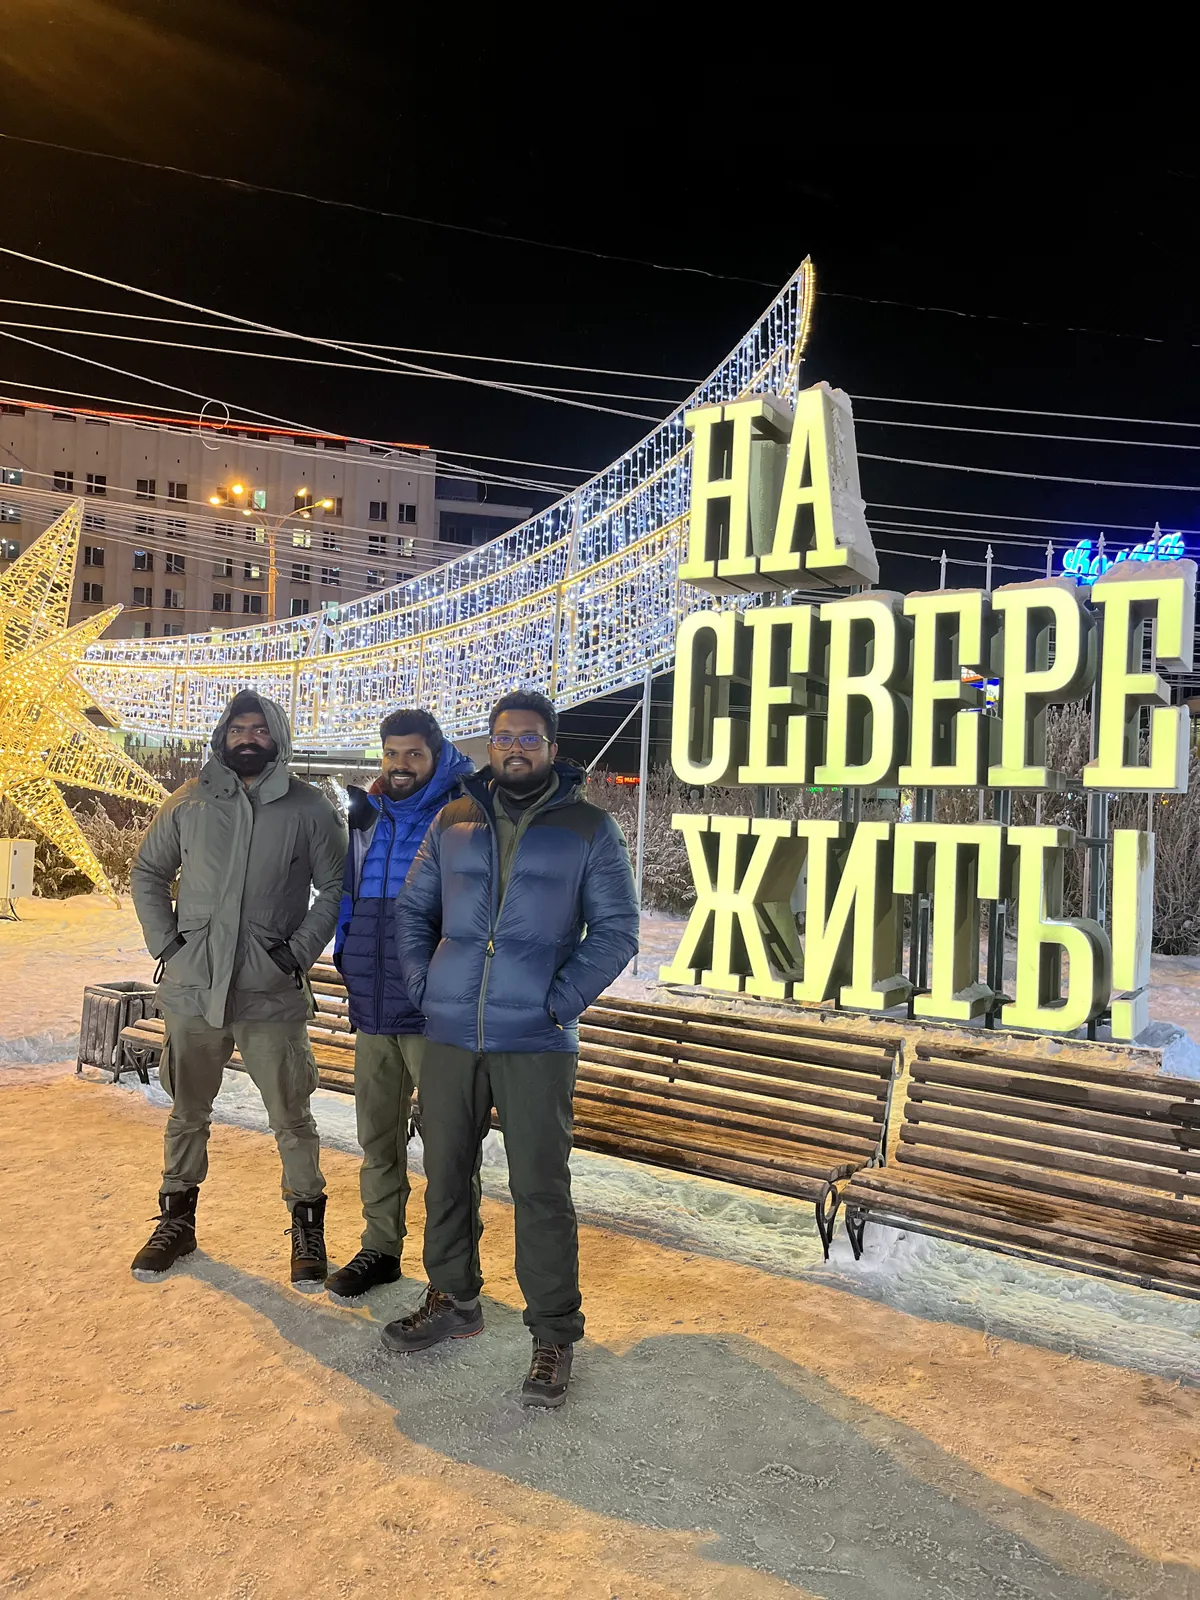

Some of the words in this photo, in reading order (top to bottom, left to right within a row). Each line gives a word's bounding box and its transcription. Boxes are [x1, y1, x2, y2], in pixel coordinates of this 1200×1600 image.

[679, 388, 856, 582] НА
[671, 578, 1186, 789] СЕВЕРЕ
[659, 812, 1142, 1040] ЖИТЬ!
